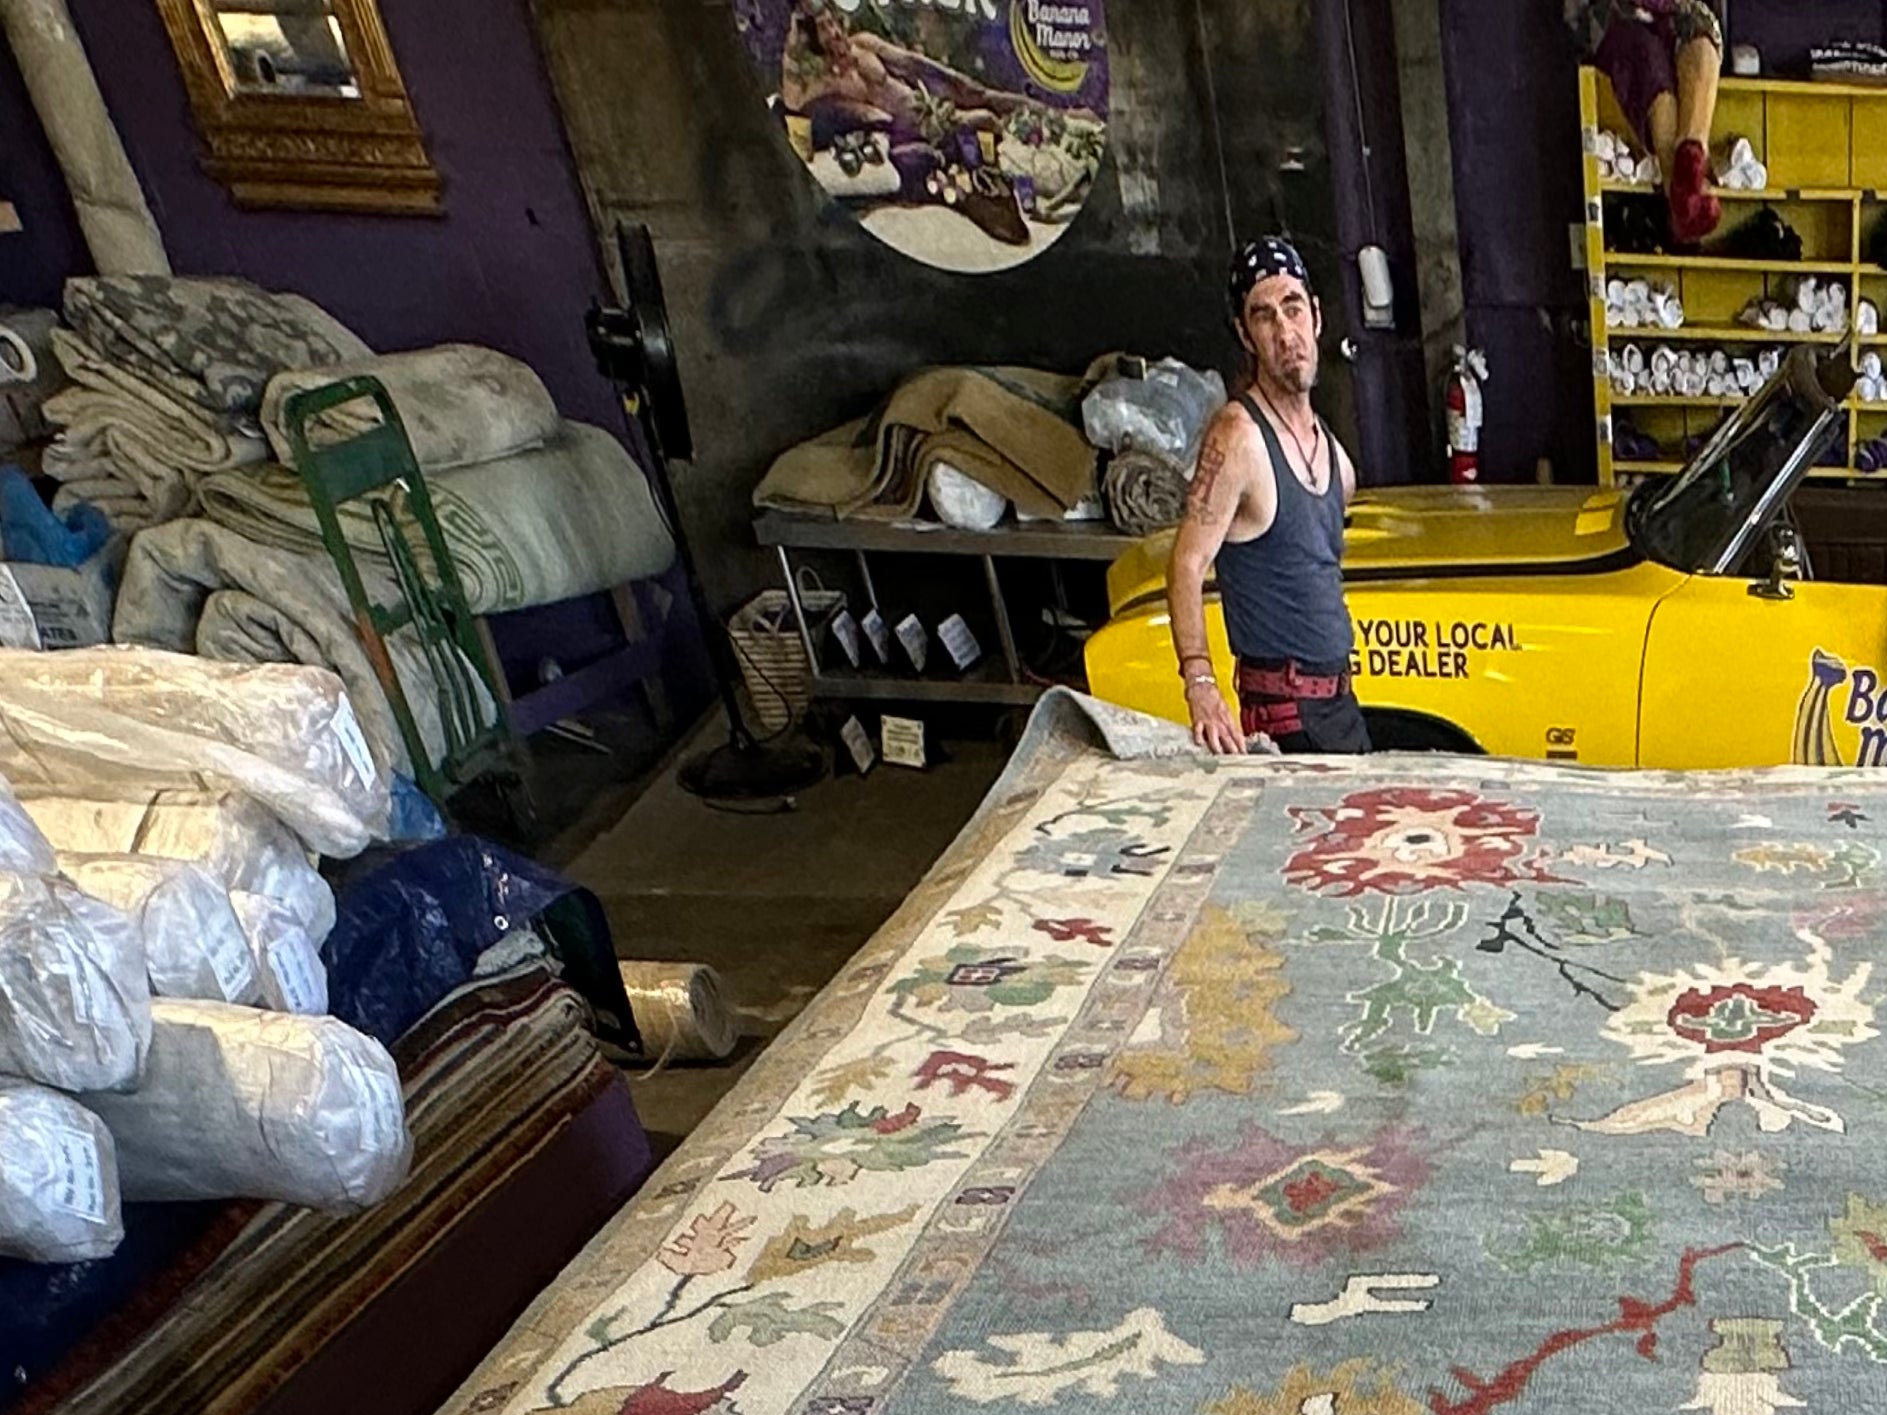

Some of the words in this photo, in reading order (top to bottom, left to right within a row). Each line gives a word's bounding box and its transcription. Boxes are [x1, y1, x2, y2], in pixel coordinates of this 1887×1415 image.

[1027, 0, 1090, 25] Banana
[1036, 22, 1091, 49] Manor
[1357, 619, 1430, 648] YOUR
[1435, 621, 1523, 651] LOCAL
[1369, 650, 1470, 678] DEALER
